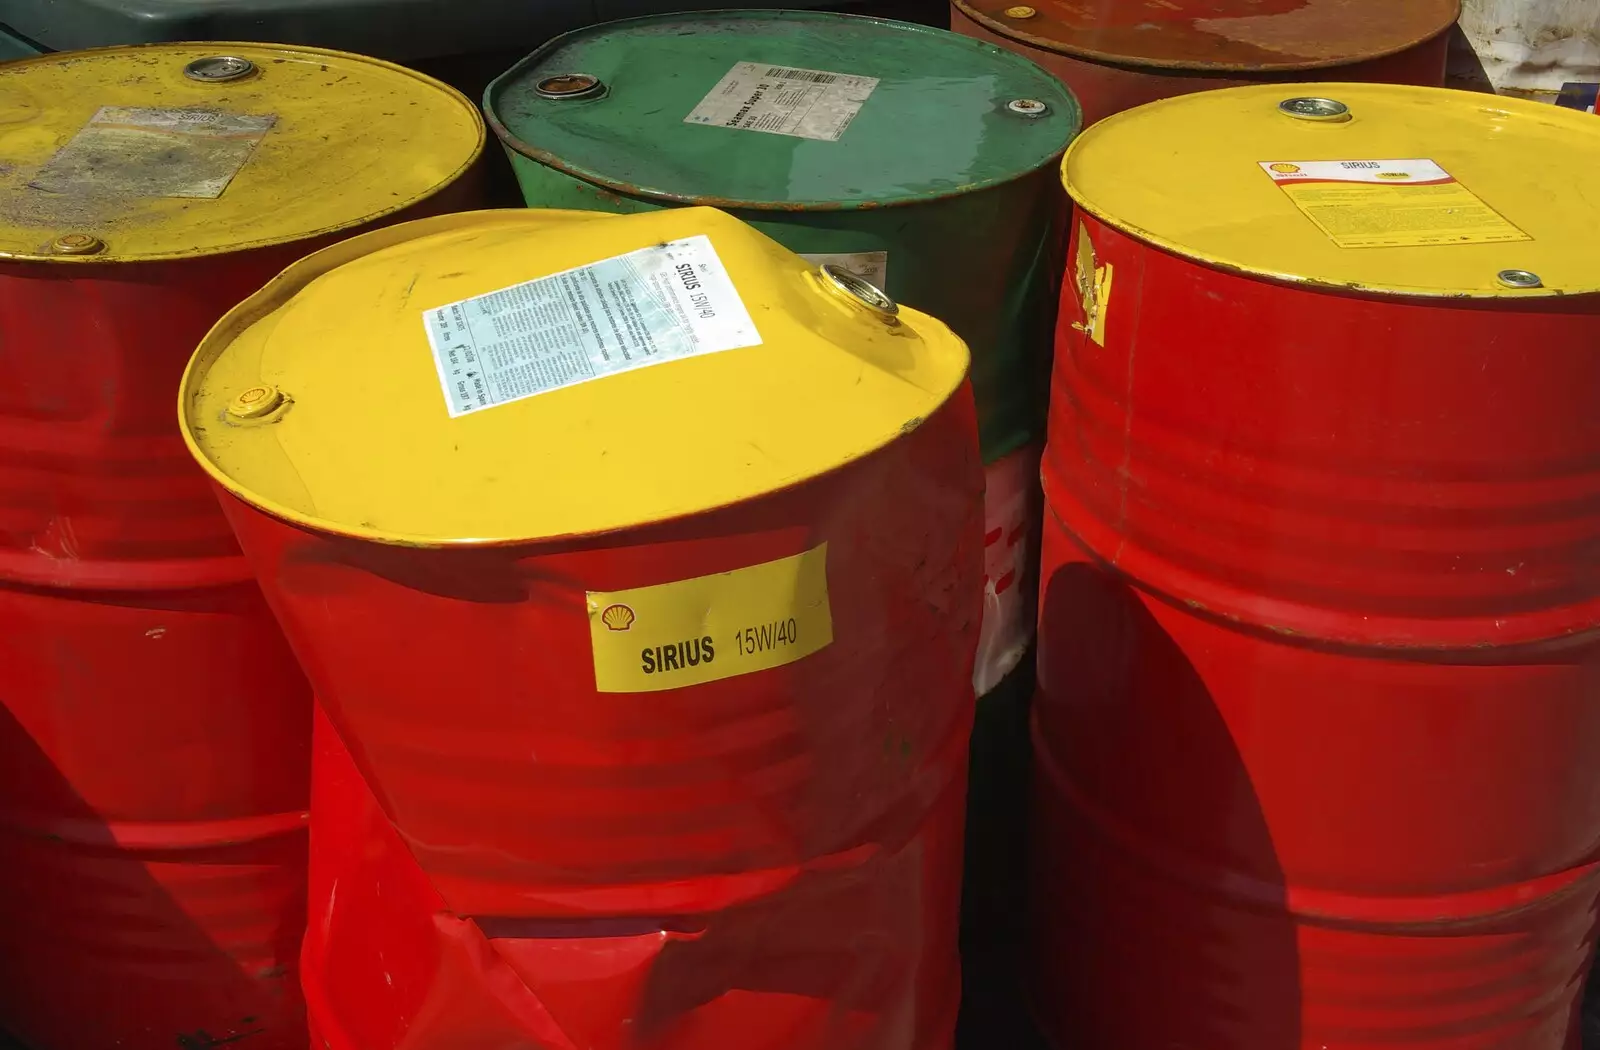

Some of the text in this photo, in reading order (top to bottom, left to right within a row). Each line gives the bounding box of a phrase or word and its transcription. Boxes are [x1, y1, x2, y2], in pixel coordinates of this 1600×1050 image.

[178, 113, 216, 122] SIRIUS
[726, 106, 750, 126] Seamax
[744, 91, 762, 105] Super
[676, 264, 715, 318] SIRIUS 15W/40
[477, 393, 486, 405] Spain
[641, 618, 796, 674] SIRIUS 15W/40
